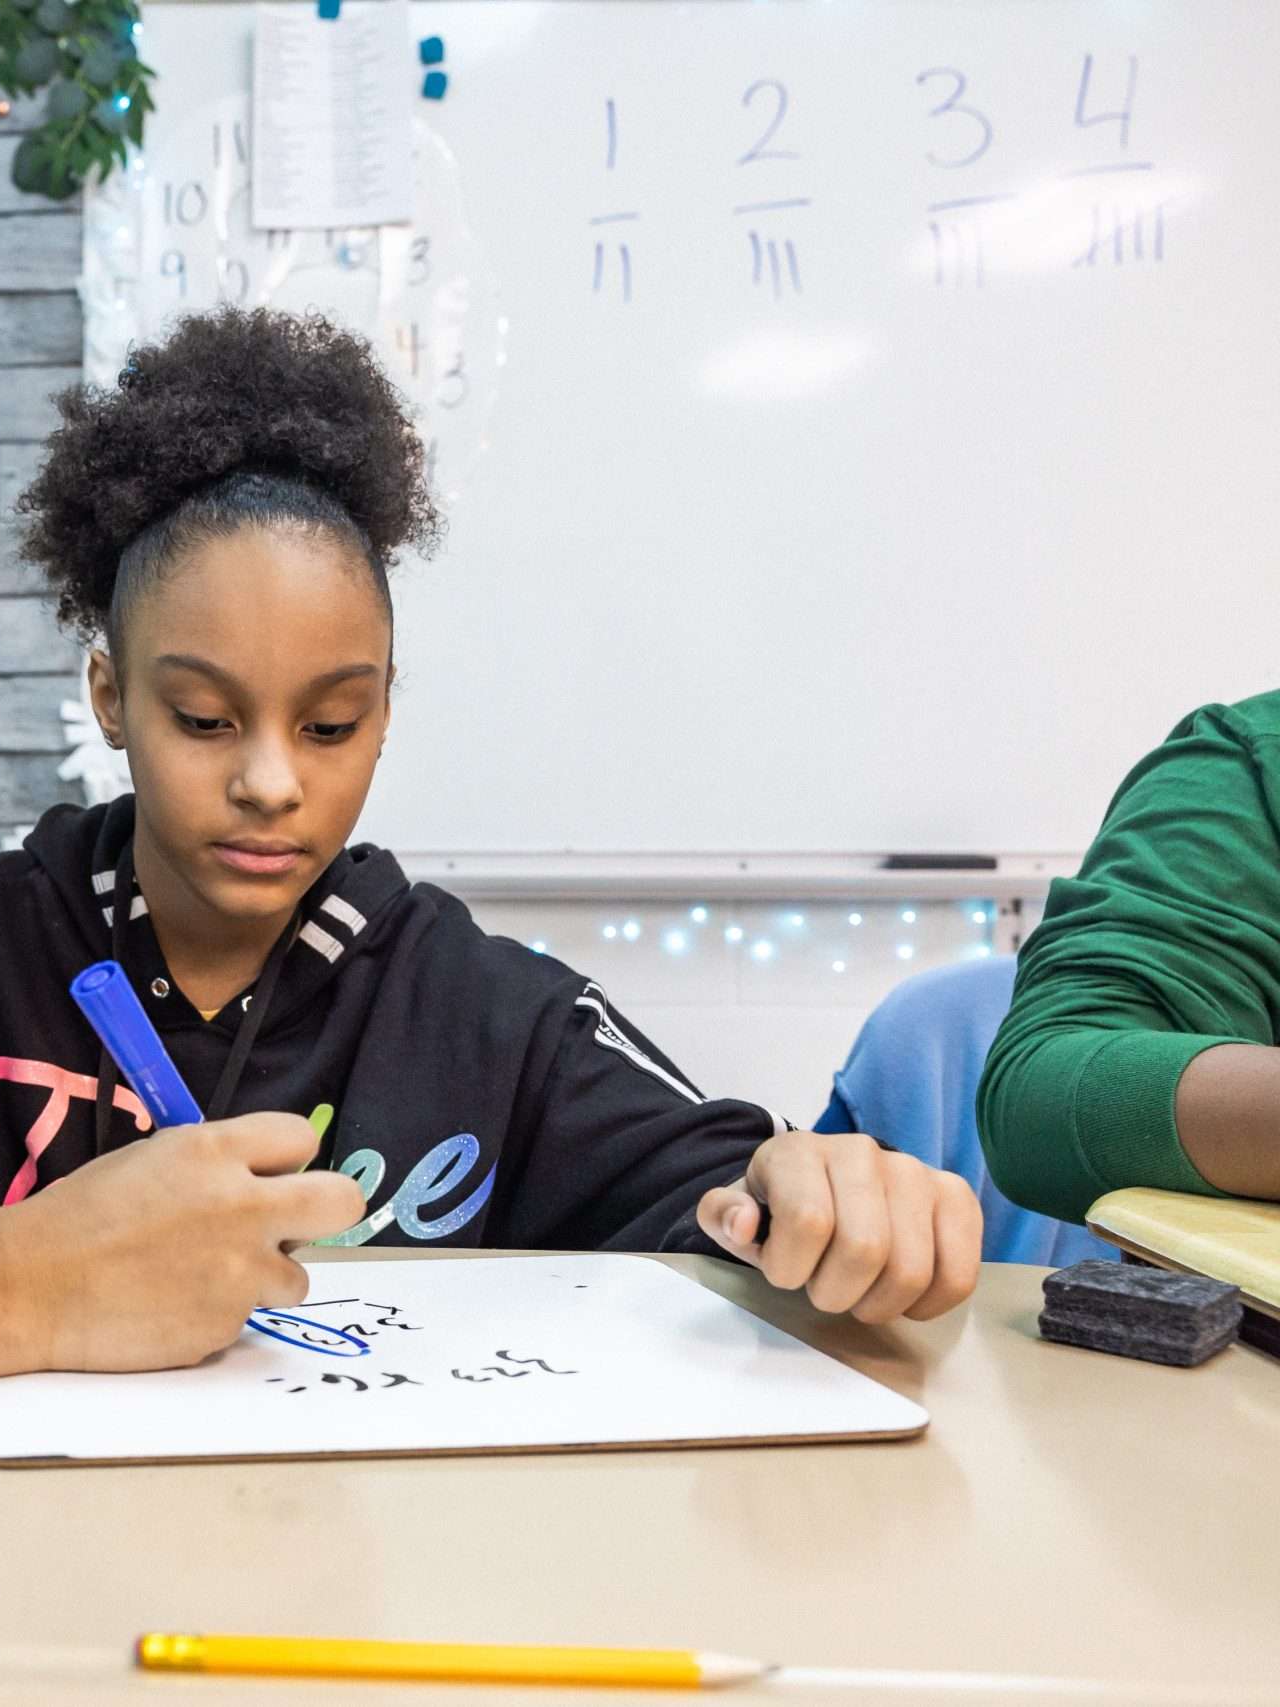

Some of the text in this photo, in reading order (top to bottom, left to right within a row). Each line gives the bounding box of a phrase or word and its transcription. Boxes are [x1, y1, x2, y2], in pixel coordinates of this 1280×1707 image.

[734, 78, 802, 167] 2
[915, 66, 994, 170] 3
[1073, 53, 1141, 150] 4
[163, 181, 209, 226] 10
